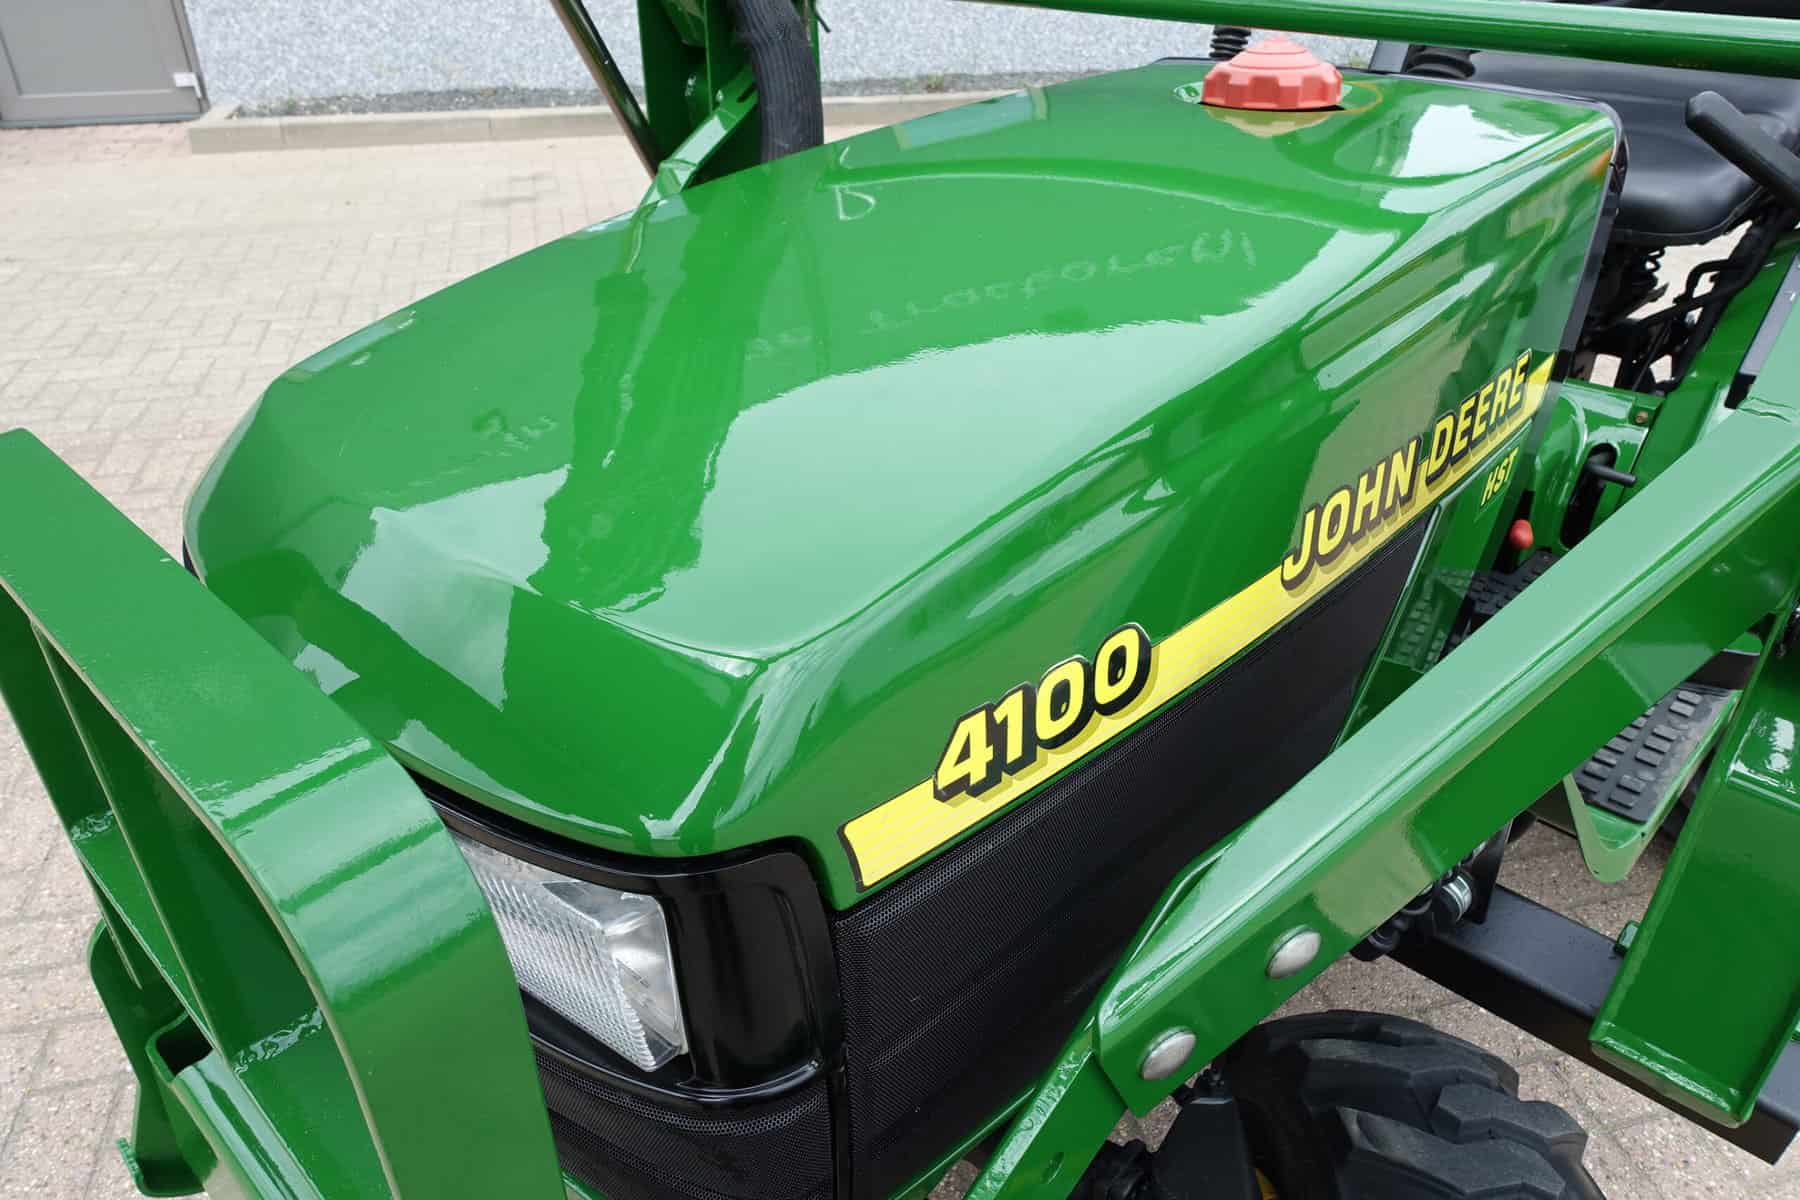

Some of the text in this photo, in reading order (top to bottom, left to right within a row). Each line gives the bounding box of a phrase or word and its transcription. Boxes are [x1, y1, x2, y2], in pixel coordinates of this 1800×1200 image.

[1281, 349, 1531, 589] JOHN DEERE
[1480, 446, 1519, 507] HST
[934, 624, 1150, 800] 4100
